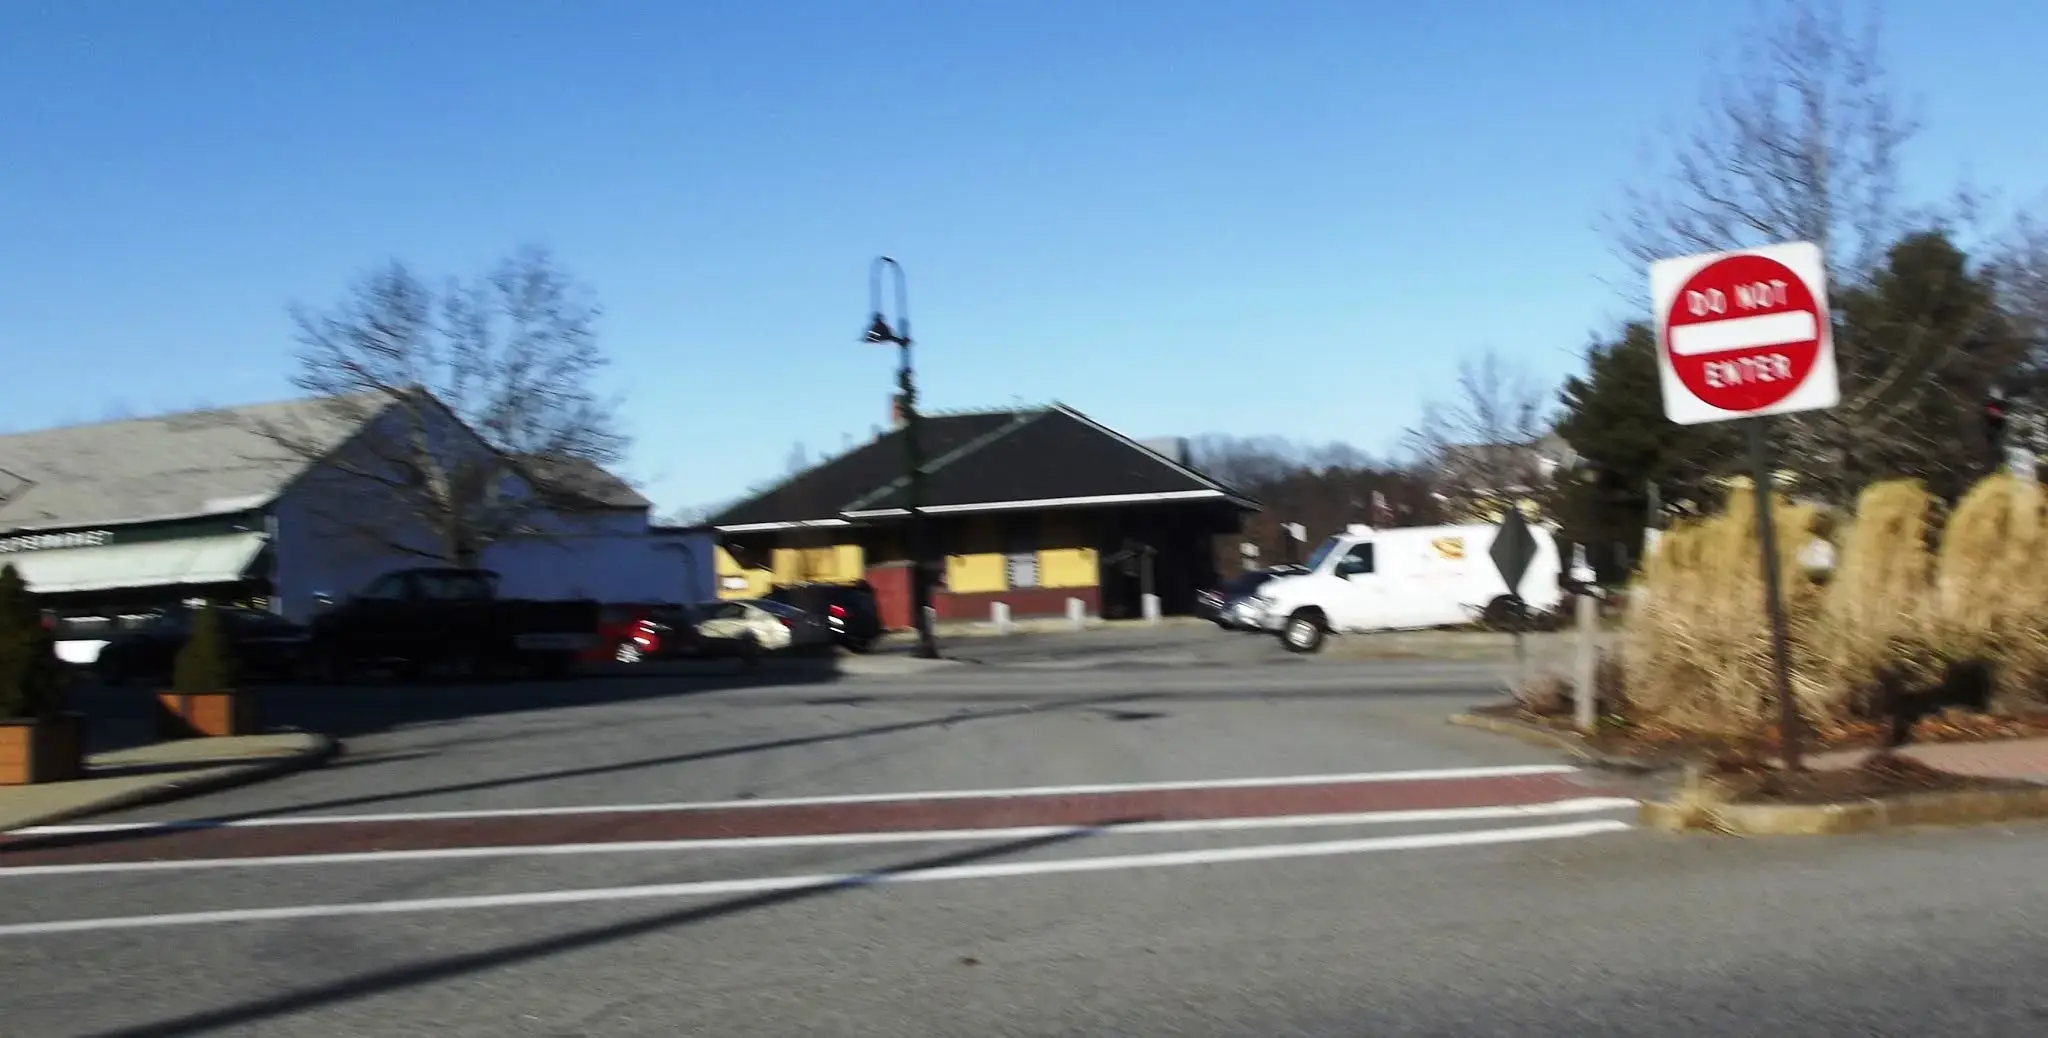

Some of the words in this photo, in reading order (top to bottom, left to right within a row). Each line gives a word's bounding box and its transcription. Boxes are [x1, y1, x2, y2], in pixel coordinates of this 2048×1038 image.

[1687, 288, 1726, 315] DO
[1734, 280, 1788, 309] NOT
[1704, 354, 1792, 387] ENTER
